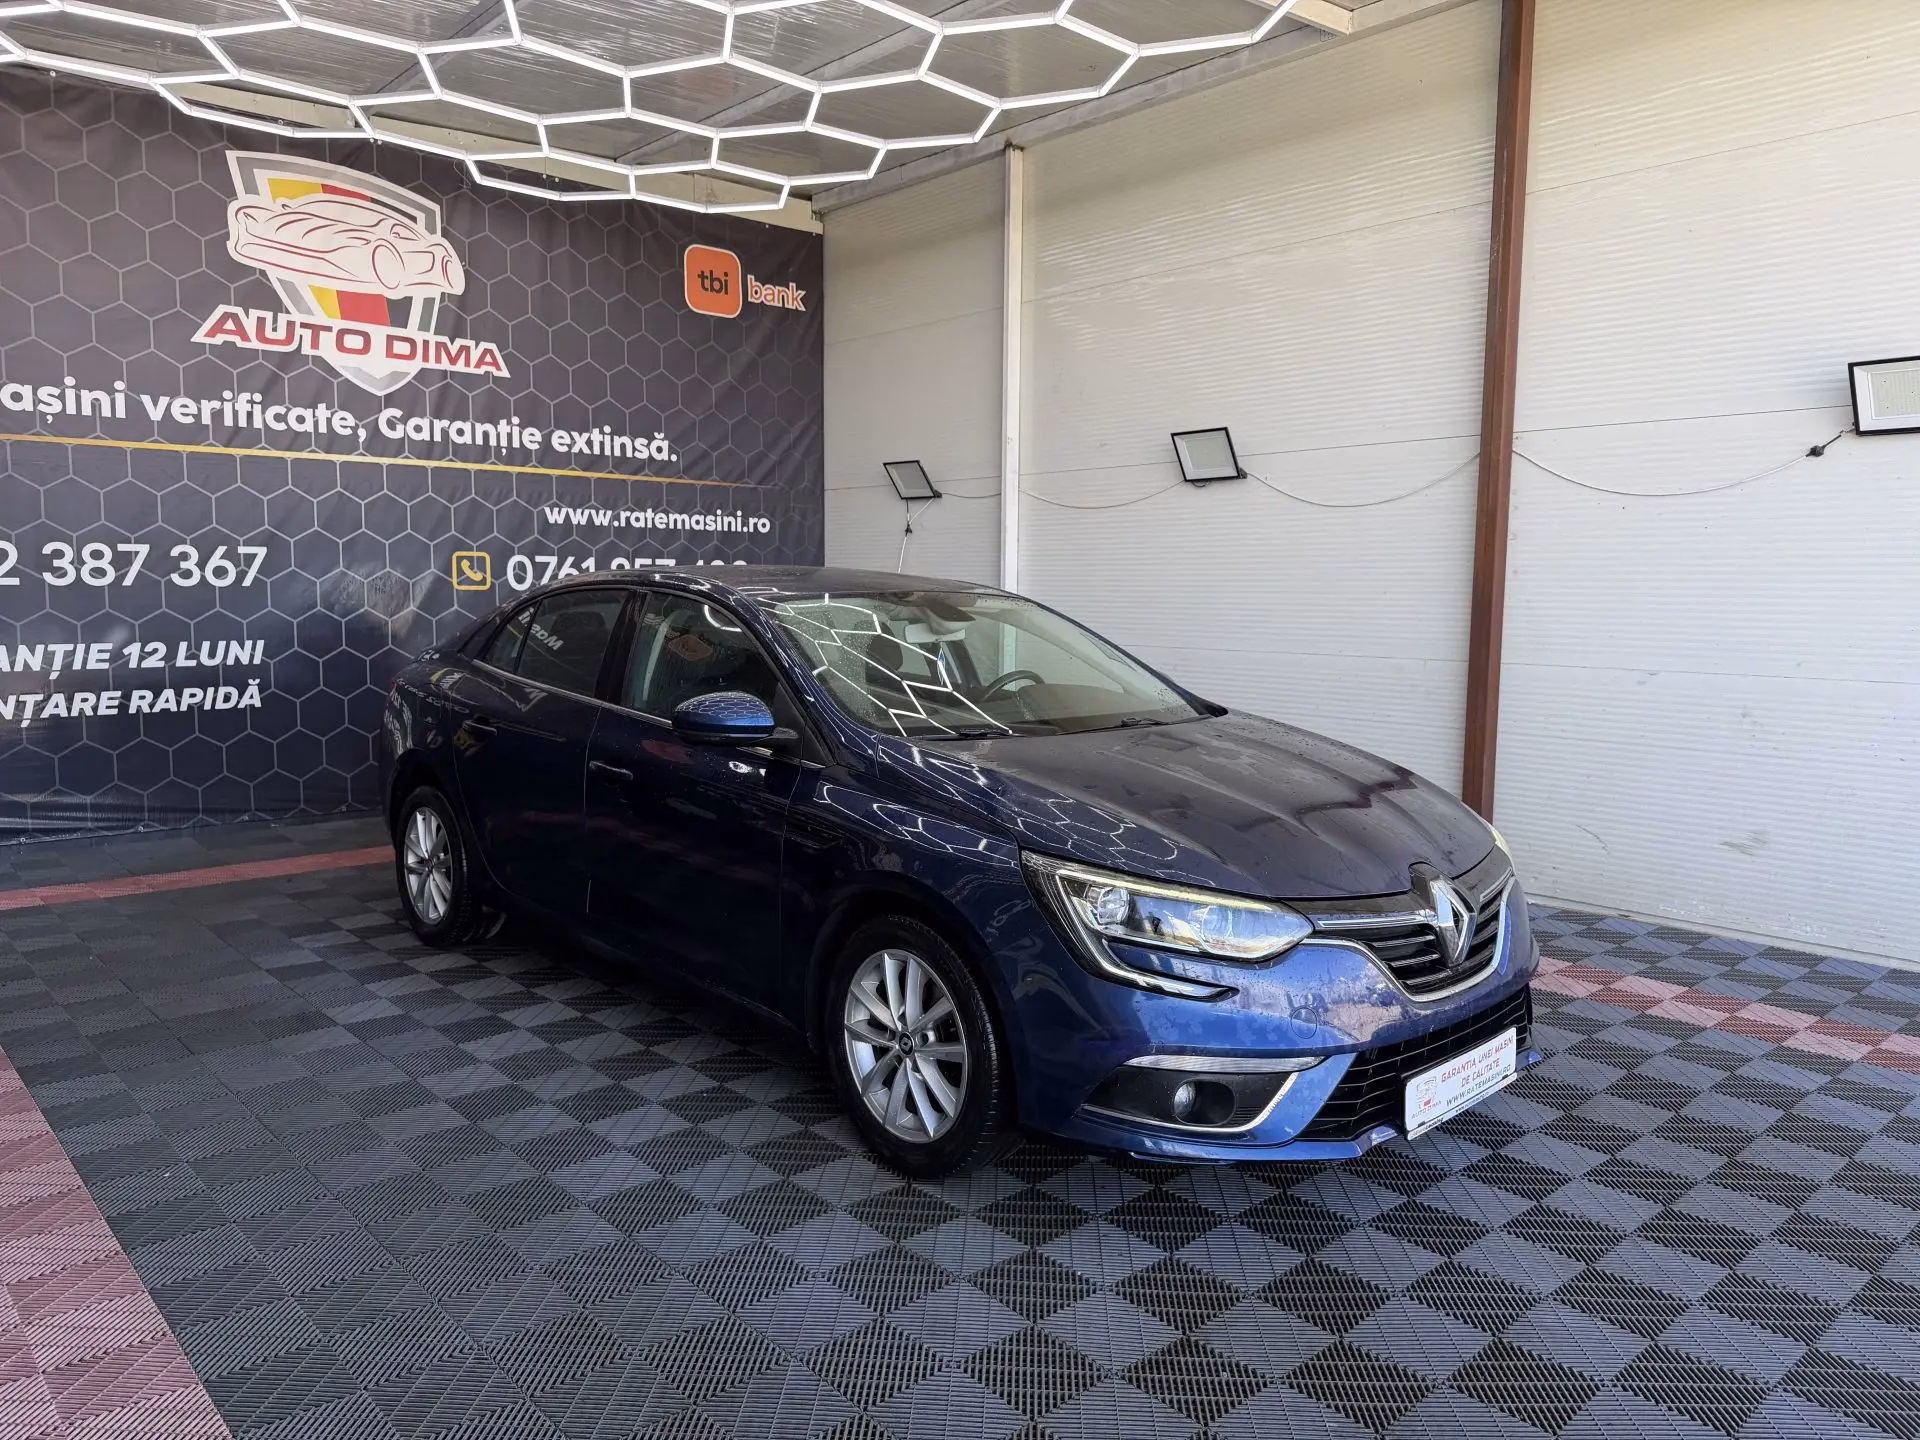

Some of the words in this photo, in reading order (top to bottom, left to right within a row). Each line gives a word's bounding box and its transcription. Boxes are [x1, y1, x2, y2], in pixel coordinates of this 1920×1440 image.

[697, 269, 729, 295] tbi
[748, 275, 806, 311] bank
[203, 311, 372, 356] AUTO
[384, 334, 502, 373] DIMA
[140, 389, 367, 443] verificate,
[377, 407, 543, 456] Garanție
[551, 425, 678, 462] extinsă.
[543, 505, 771, 534] www.ratemasini.ro
[41, 541, 150, 587] 387
[170, 544, 268, 587] 367
[122, 641, 167, 669] 12
[175, 639, 265, 667] LUNI
[128, 678, 262, 714] RAPIDĂ
[1461, 1075, 1471, 1088] DE
